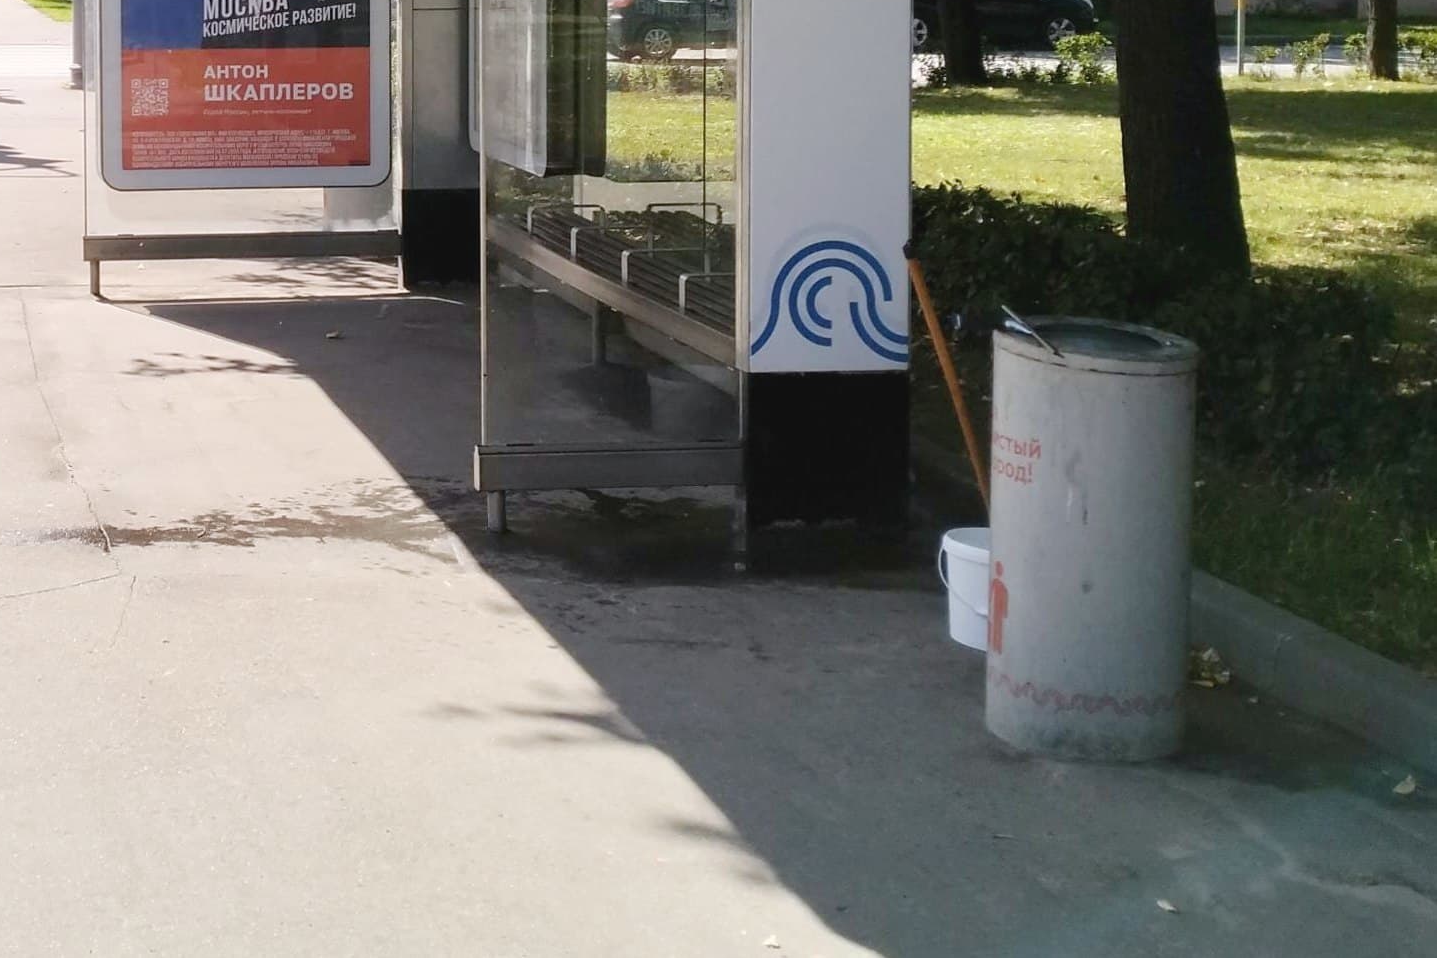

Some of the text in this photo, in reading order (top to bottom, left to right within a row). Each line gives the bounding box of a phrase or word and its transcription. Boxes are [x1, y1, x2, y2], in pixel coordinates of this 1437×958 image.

[203, 2, 356, 38] КОСМИЧЕСКОЕ РАЗВИТИЕ!
[203, 64, 268, 80] АНТОН
[204, 82, 355, 101] ШКАПЛЕРОВ
